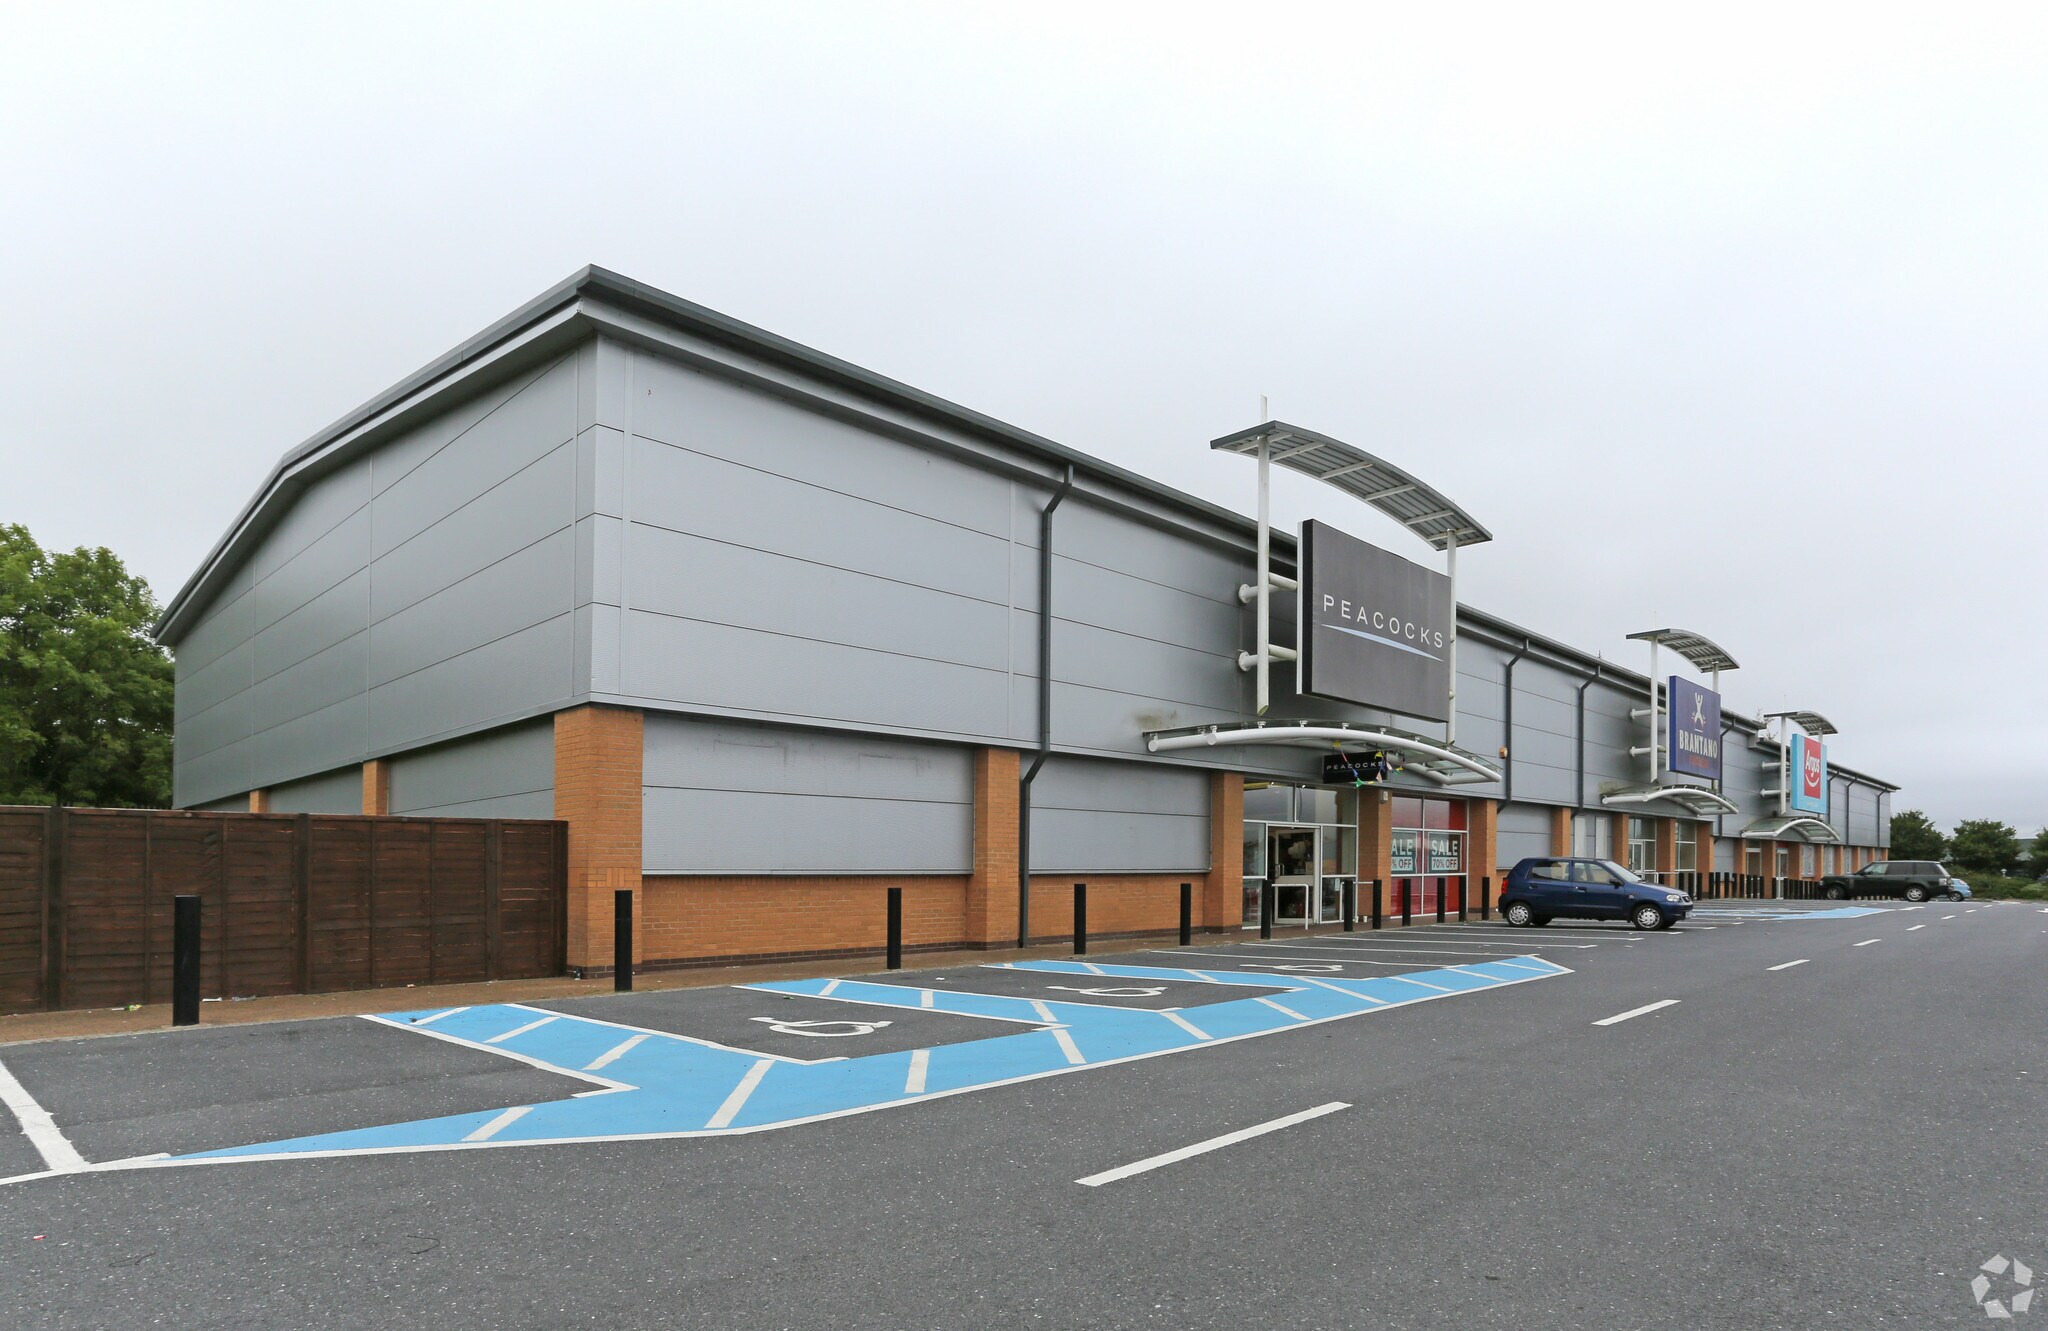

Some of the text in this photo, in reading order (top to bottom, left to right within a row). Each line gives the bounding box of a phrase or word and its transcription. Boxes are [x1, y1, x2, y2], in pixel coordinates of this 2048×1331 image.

[1323, 594, 1443, 648] PEACOCKS
[1680, 730, 1718, 758] BRANTANO
[1326, 762, 1383, 770] PEACOCKS
[1805, 749, 1820, 778] Argos
[1391, 838, 1413, 855] ALE
[1431, 839, 1458, 856] SALE
[1398, 858, 1412, 868] OFF
[1445, 858, 1457, 868] OFF
